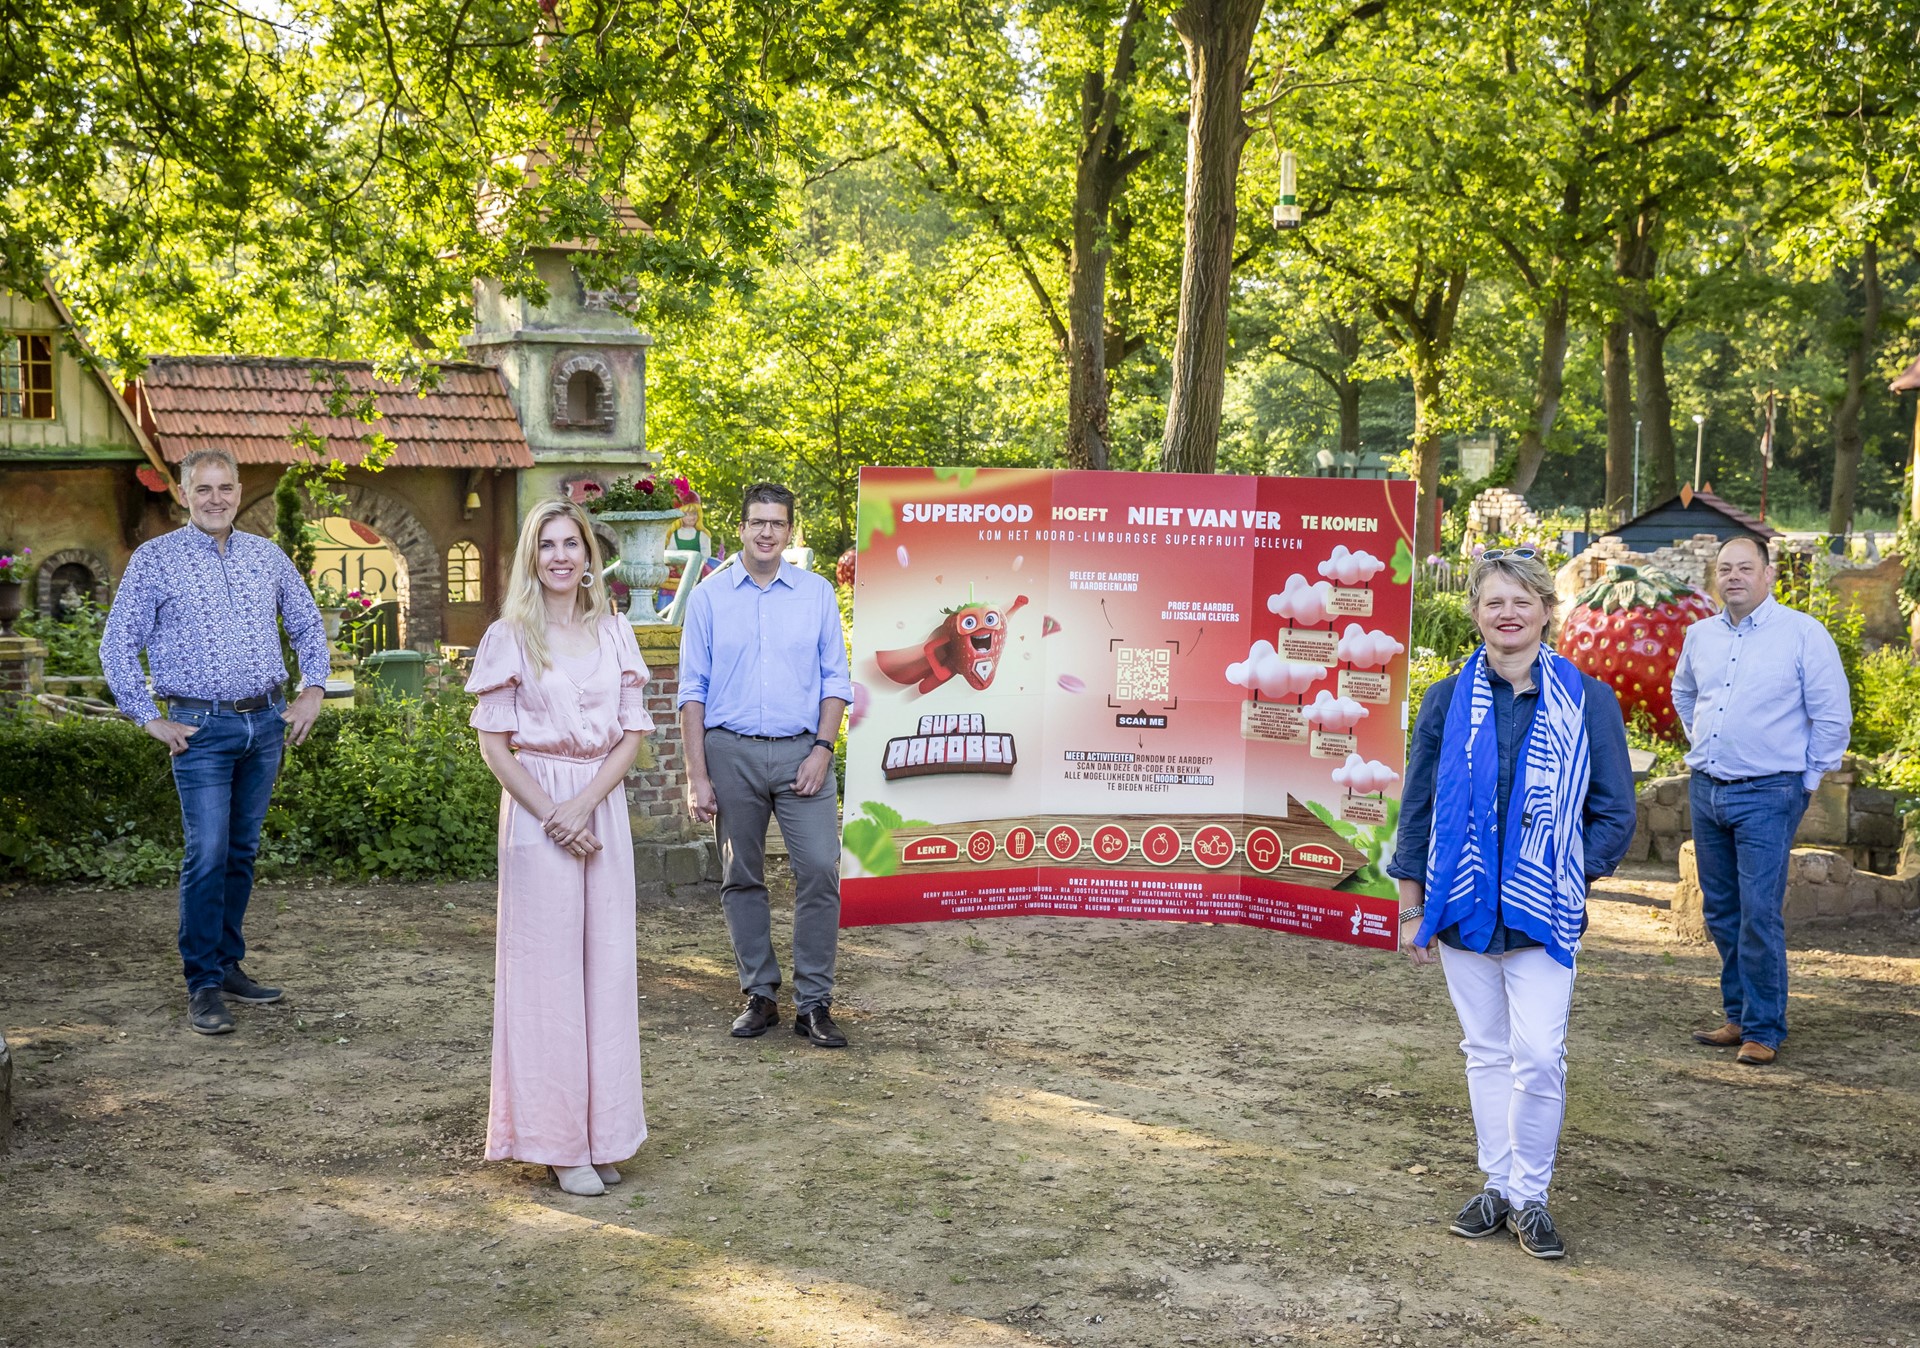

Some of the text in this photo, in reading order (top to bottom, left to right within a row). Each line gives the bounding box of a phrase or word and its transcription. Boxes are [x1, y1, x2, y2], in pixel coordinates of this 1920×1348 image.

[902, 503, 1378, 532] SUPERFOOD HOEFT NIET VAN VER TE KOMEN
[978, 530, 1303, 550] KOM HET NOORD-LIMBURGSE SUPERFRUIT BELEVEN
[1070, 571, 1139, 582] BELEEF DE AARDBEI
[1070, 582, 1138, 592] IN AARDBEIENLAND
[1168, 601, 1234, 612] PROEF DE AARDBEI
[1162, 611, 1240, 622] BIJ IJSSALON CLEVERS
[920, 714, 983, 735] SUPER
[1119, 717, 1164, 726] SCAN ME
[886, 735, 1013, 769] AARDBEI
[1066, 752, 1213, 764] MEER ACTIVITEITEN RONDOM DE AARDBEI?
[1077, 762, 1201, 774] SCAN DAN DEZE QR-CODE EN BEKIJK
[1064, 772, 1213, 785] ALLE MOGELIJKHEDEN DIE NOORD-LIMBURG
[1108, 782, 1169, 792] TE BIEDEN HEEFT!
[917, 845, 947, 855] LENTE
[1300, 852, 1334, 865] HERFST
[1091, 879, 1128, 887] PARTNERS
[1142, 881, 1202, 890] NOORD-LIMBURG
[1138, 890, 1182, 898] THEATERHOTEL
[1297, 904, 1318, 913] MUSEUM
[1327, 908, 1344, 917] LOCHT
[976, 903, 1017, 912] PAARDENSPORT
[1215, 909, 1247, 918] PARKHOTEL
[1248, 913, 1264, 921] HORST
[1302, 921, 1312, 929] HILL
[1274, 908, 1296, 917] CLEVERS
